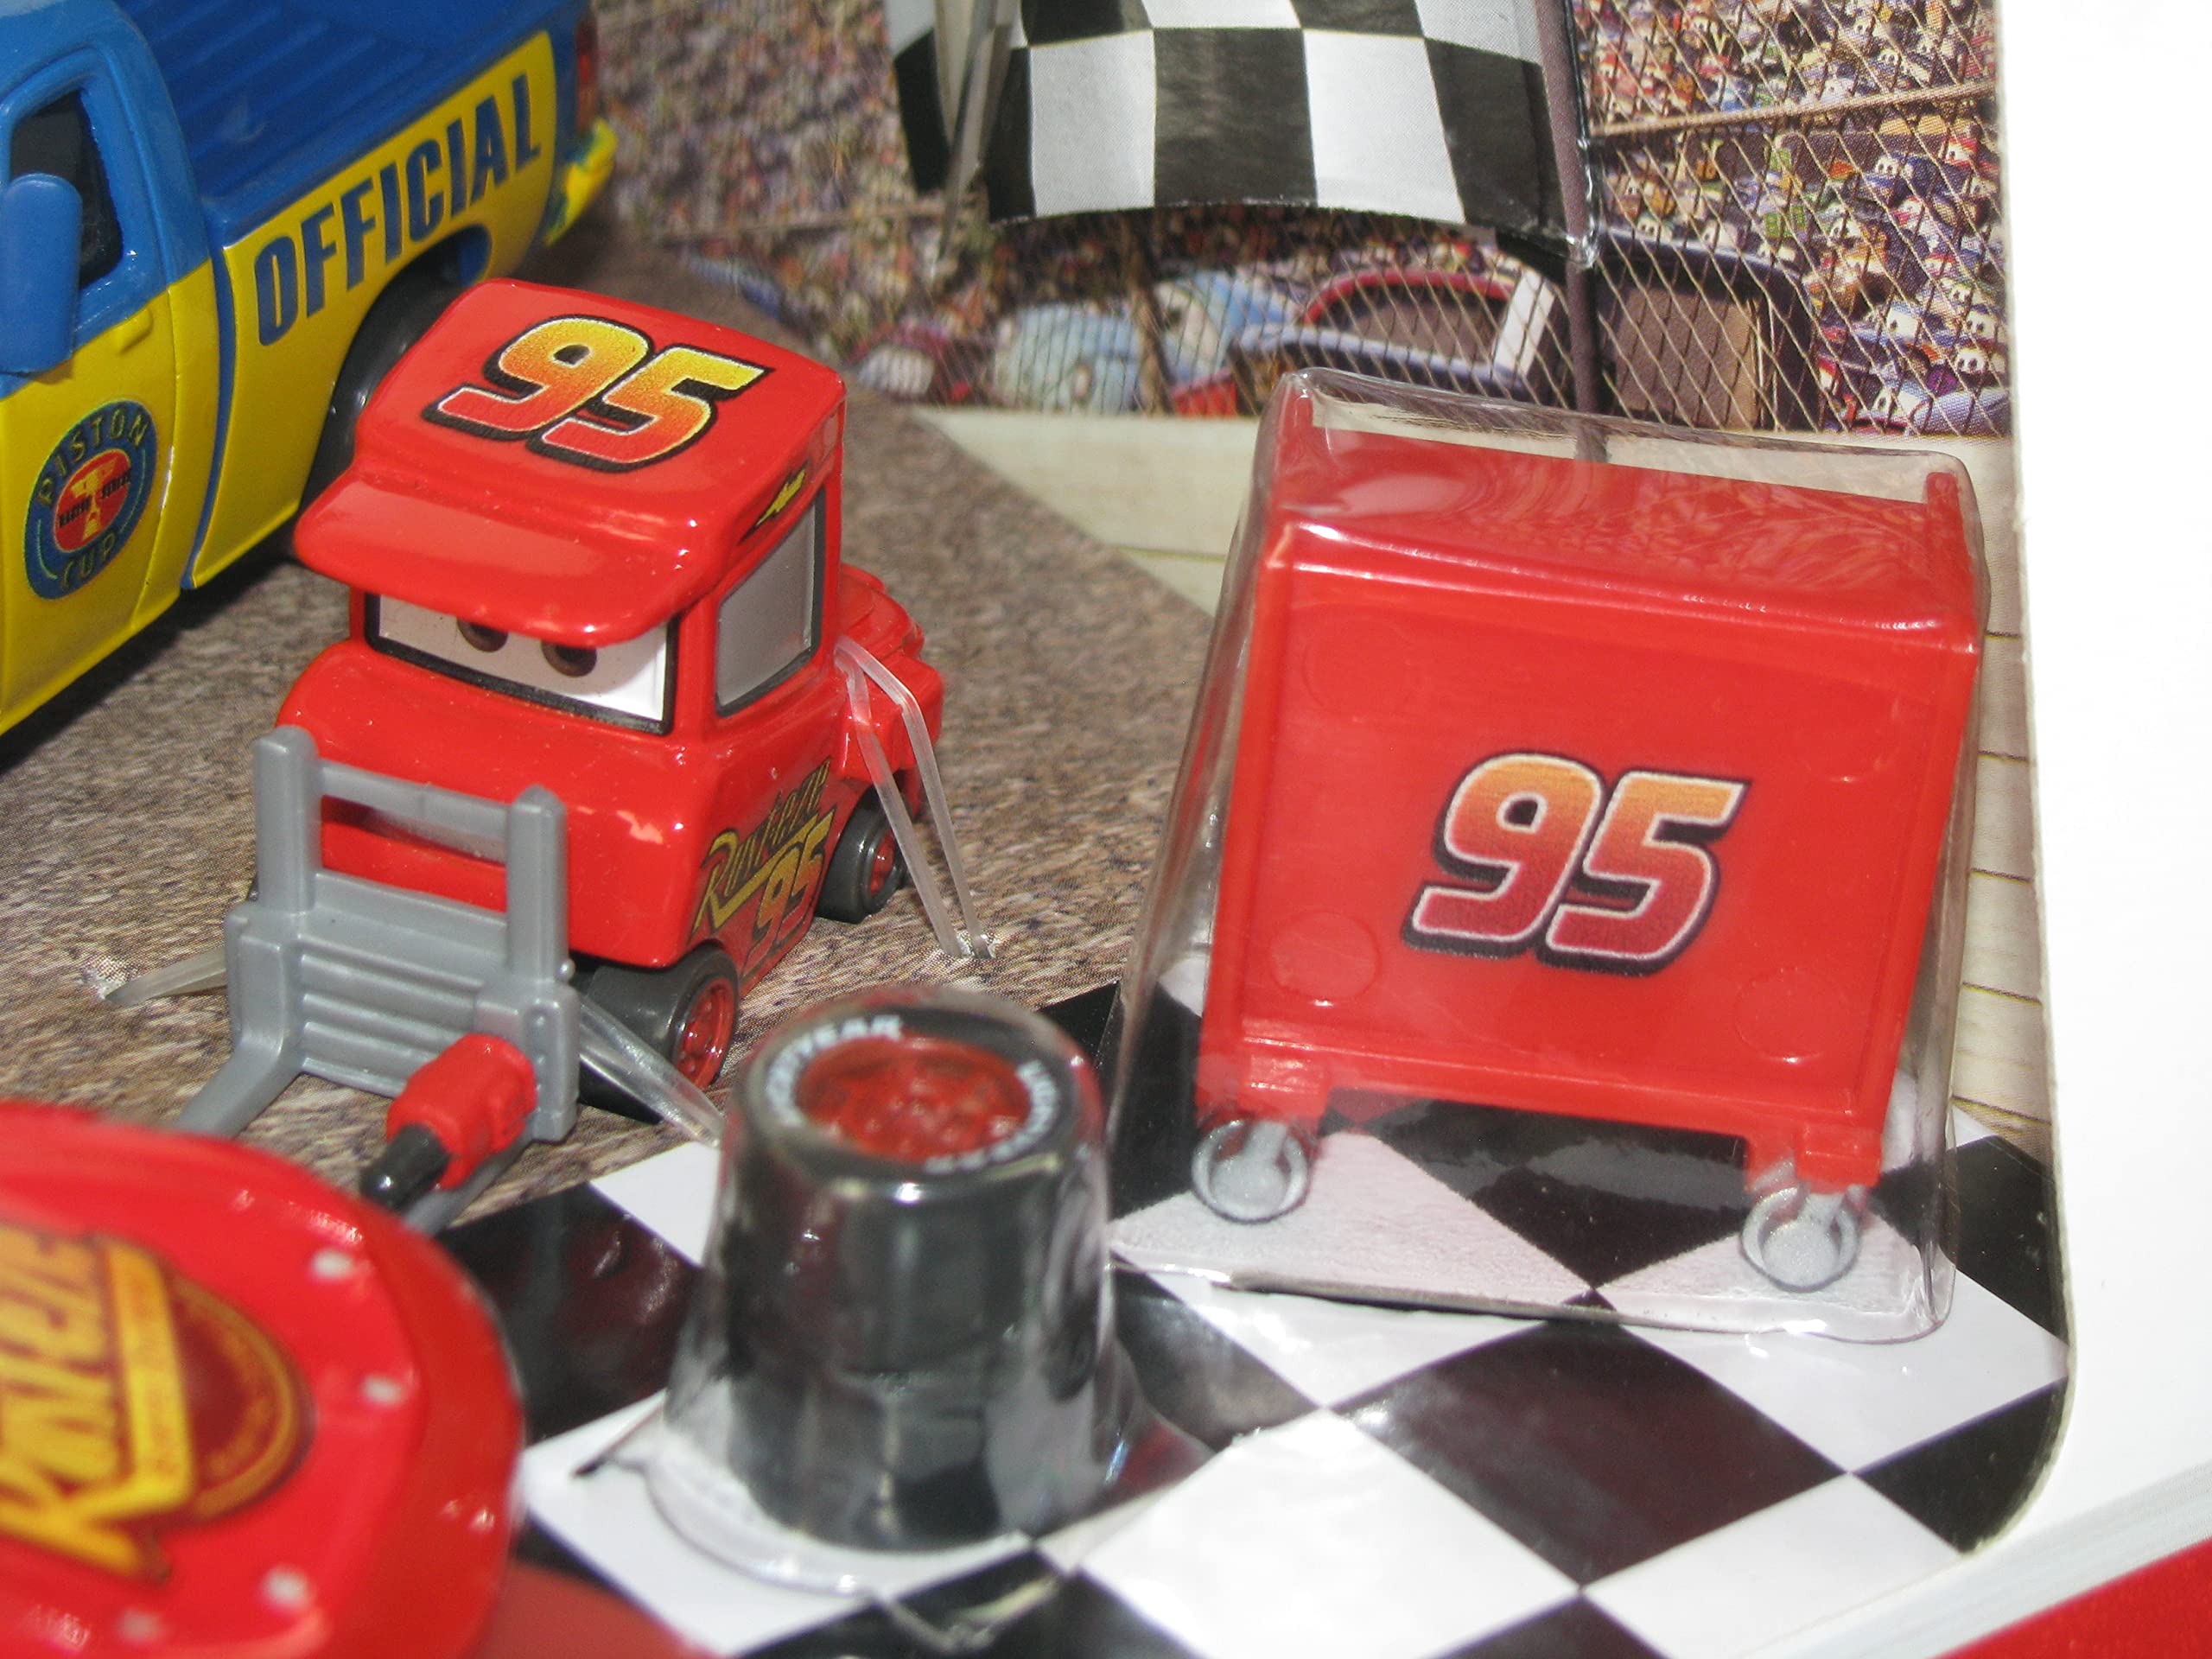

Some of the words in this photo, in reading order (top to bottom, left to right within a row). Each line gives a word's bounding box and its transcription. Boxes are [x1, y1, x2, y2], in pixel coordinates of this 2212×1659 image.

[254, 71, 541, 346] OFFICIAL
[38, 406, 149, 506] PISTON
[422, 314, 775, 474] 95
[61, 532, 117, 589] CUP
[740, 804, 836, 982] 95
[1400, 749, 1751, 978] 95
